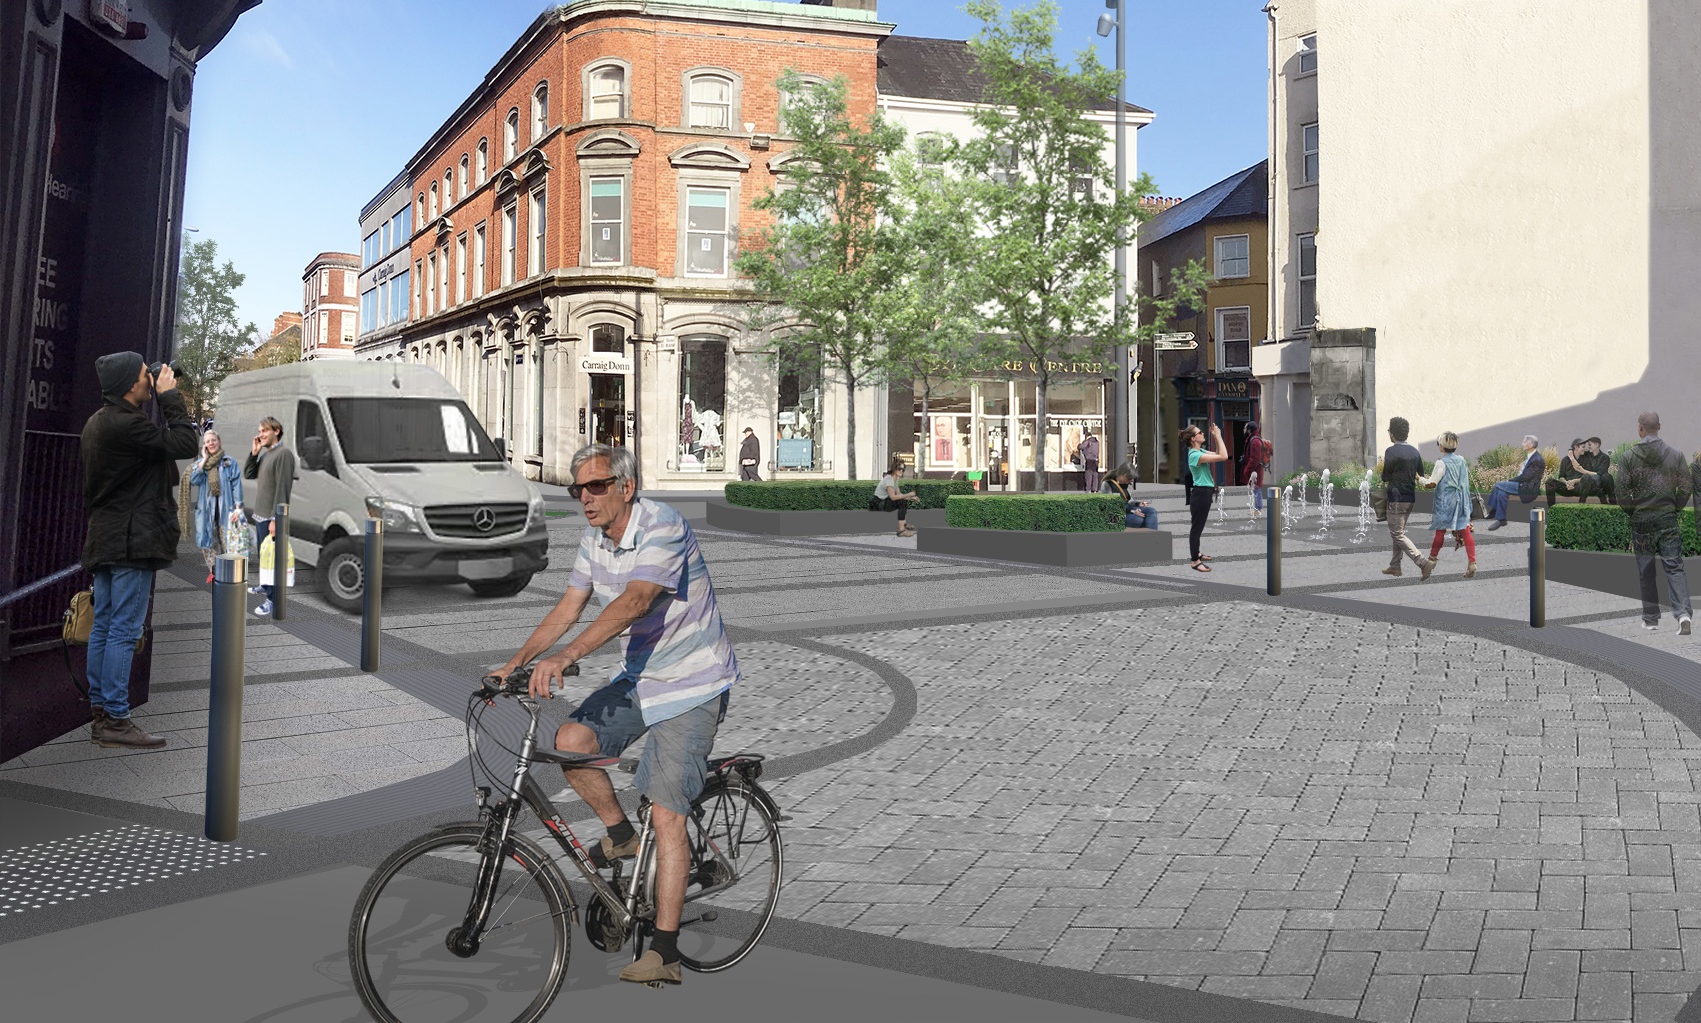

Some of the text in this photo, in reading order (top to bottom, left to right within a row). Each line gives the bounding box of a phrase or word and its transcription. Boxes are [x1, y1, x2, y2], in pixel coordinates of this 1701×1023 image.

[582, 360, 630, 371] Carraig Donn
[550, 814, 597, 874] MILES
